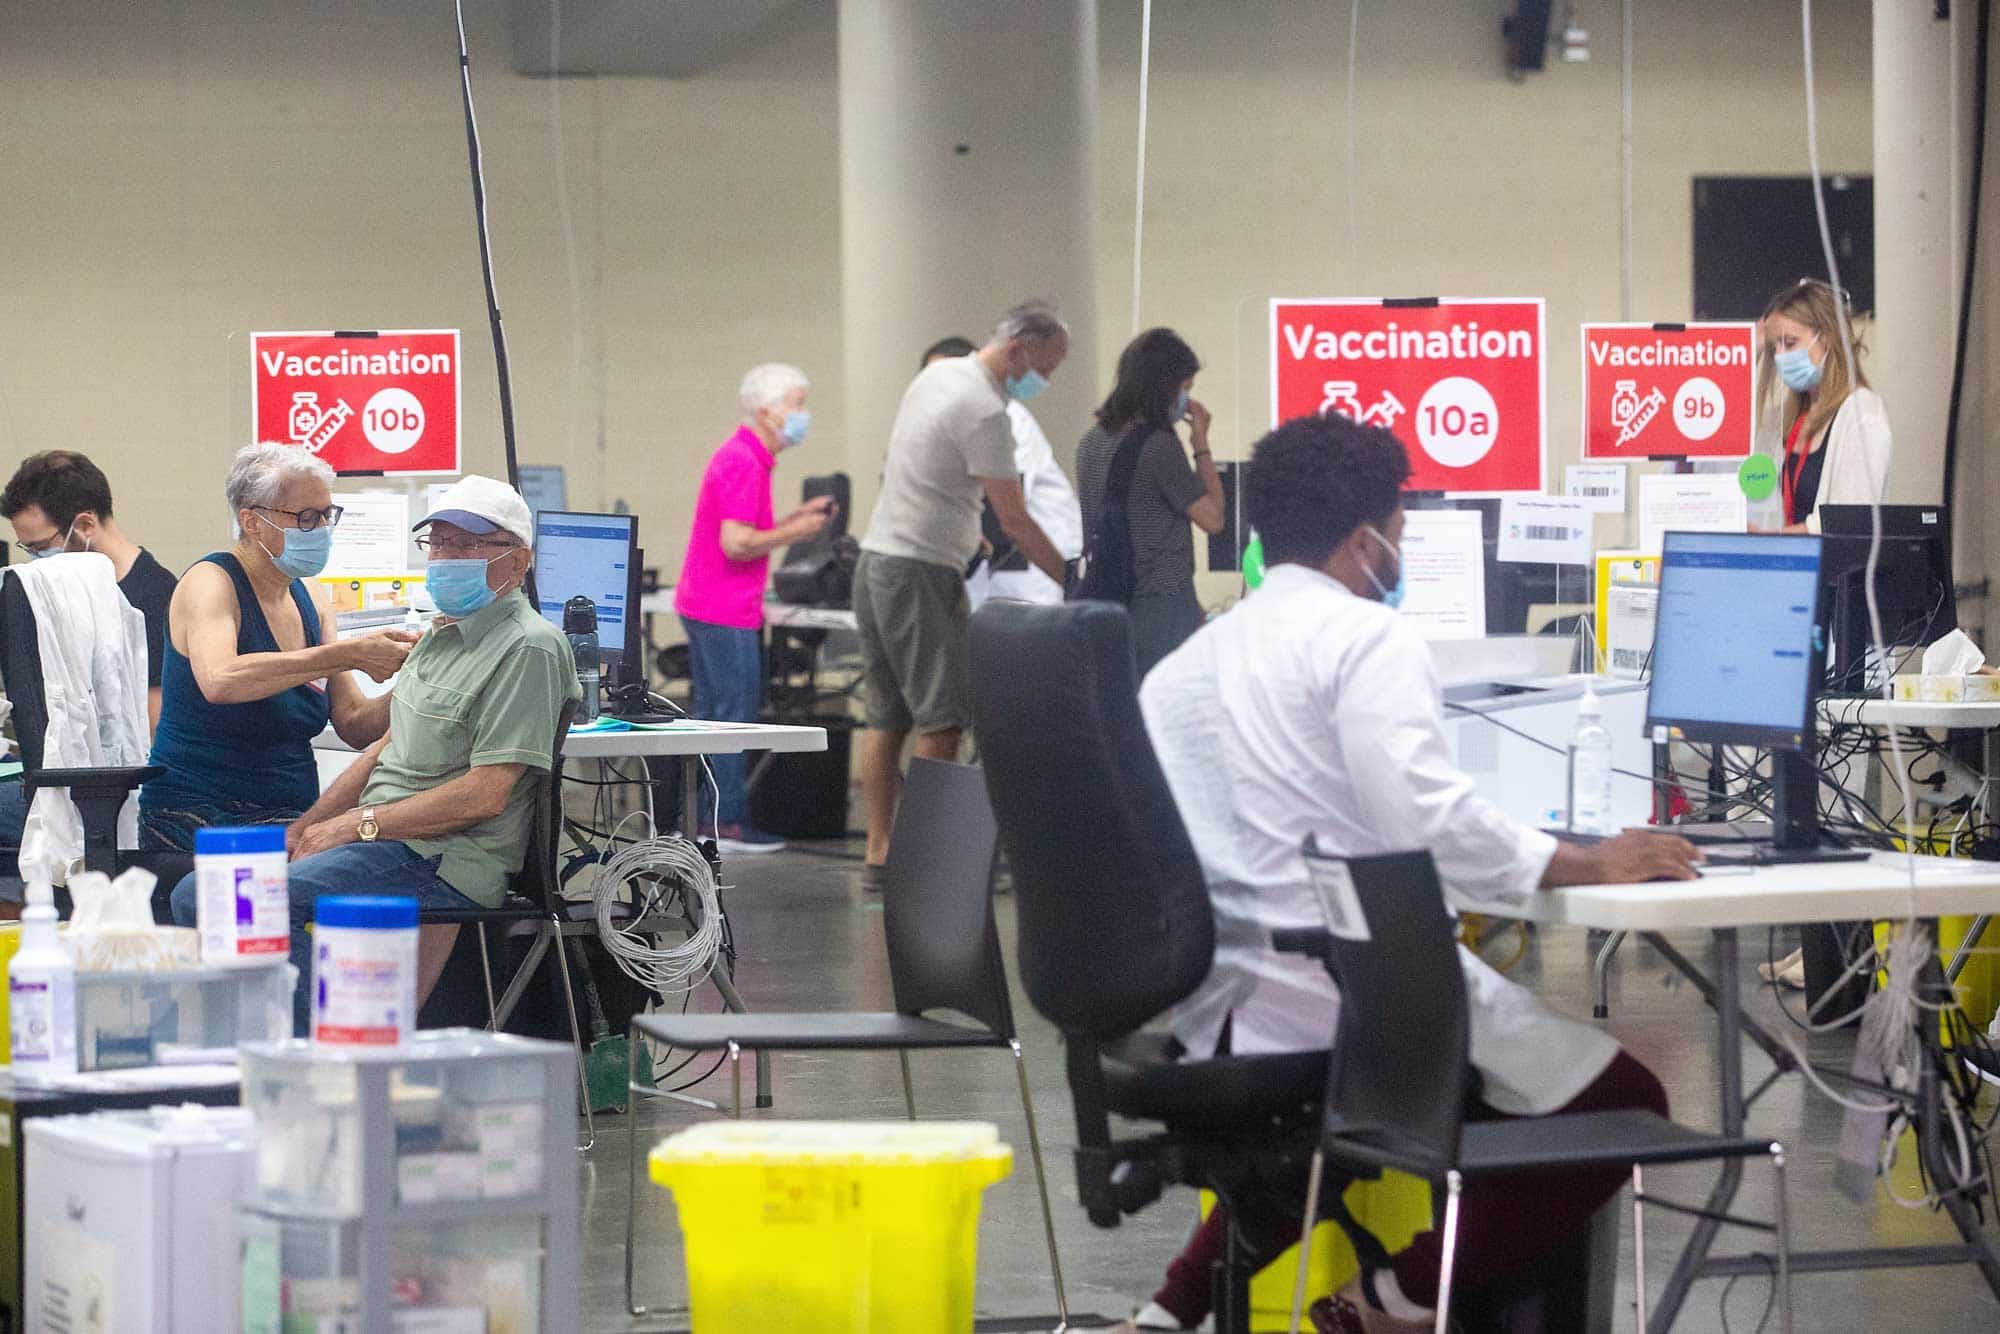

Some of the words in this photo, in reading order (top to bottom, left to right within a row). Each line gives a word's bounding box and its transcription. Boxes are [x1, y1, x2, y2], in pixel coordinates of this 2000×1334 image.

[1283, 321, 1533, 361] Vaccination
[1589, 339, 1748, 367] Vaccination
[261, 347, 451, 377] Vaccination
[367, 407, 419, 431] 10b
[1424, 404, 1490, 437] 10a
[1683, 395, 1715, 419] 9b
